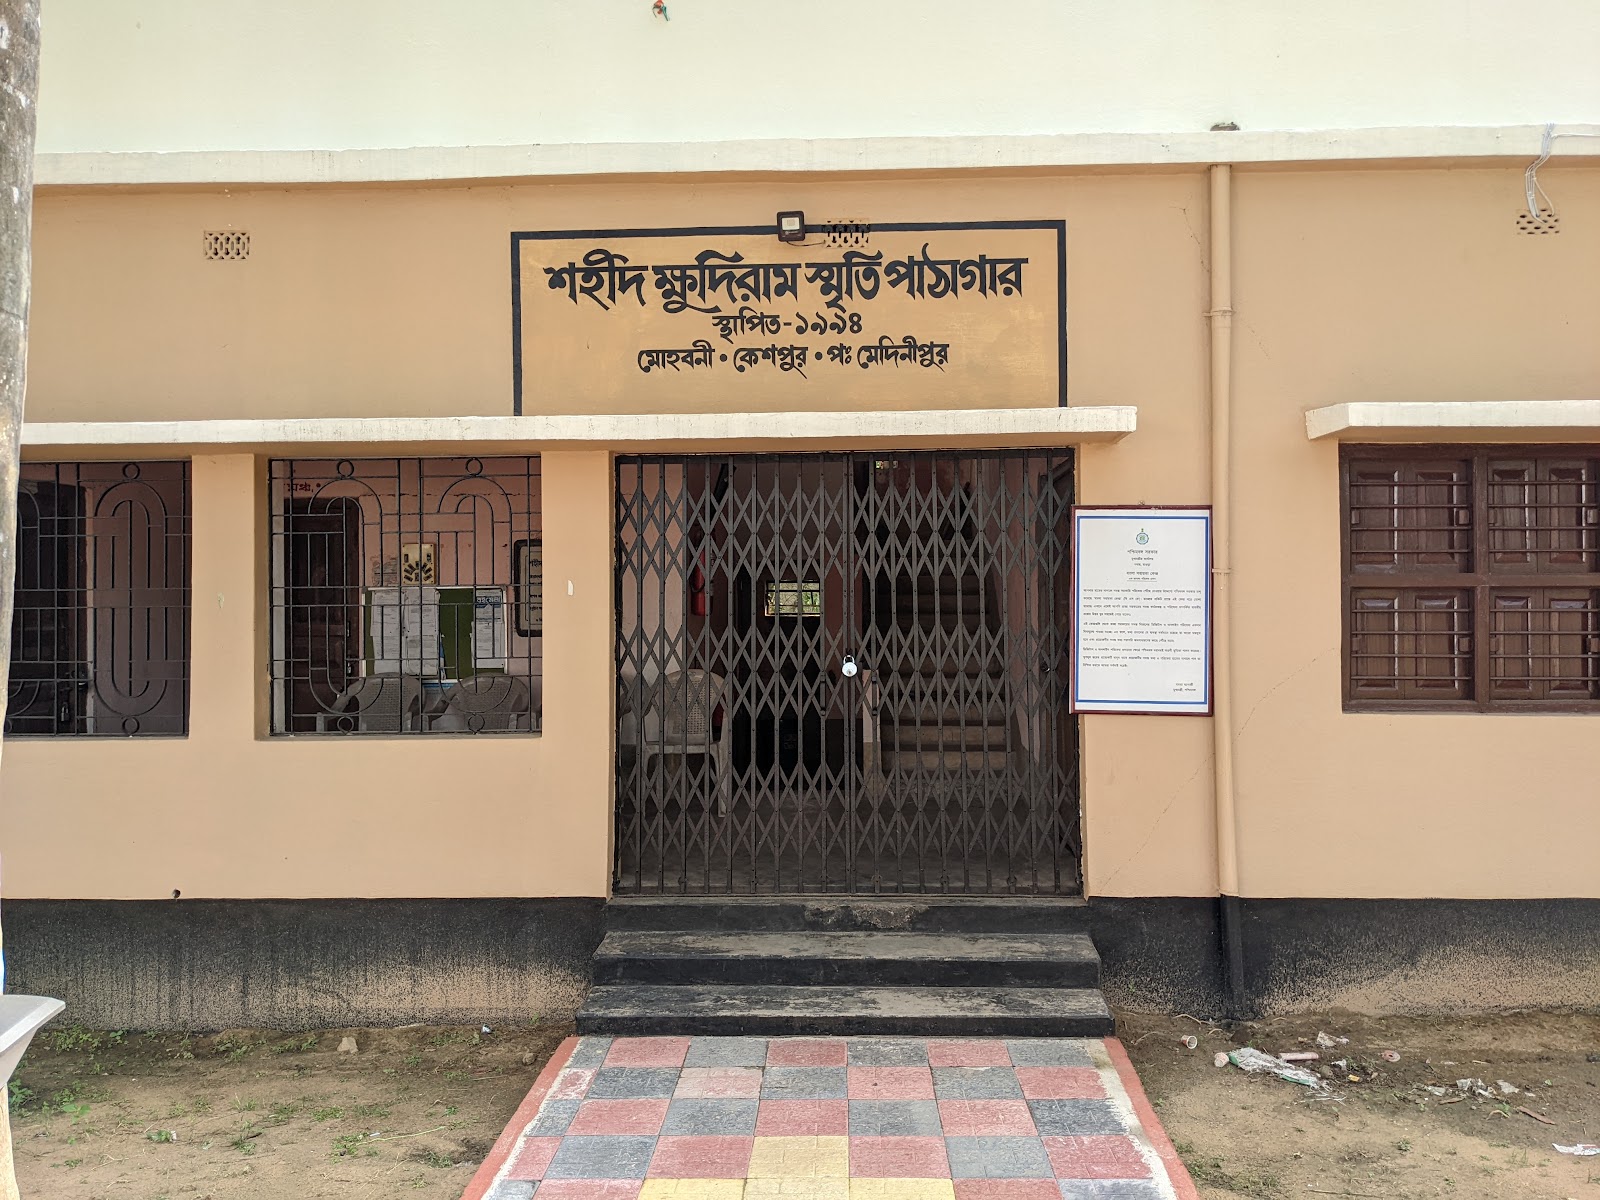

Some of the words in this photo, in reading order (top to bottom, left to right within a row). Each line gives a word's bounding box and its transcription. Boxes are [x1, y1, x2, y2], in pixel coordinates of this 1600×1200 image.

[543, 249, 648, 311] শহীদ
[651, 249, 802, 313] ক্ষুদিরাম
[804, 250, 884, 313] স্মৃতি
[884, 243, 1029, 300] পাঠাগার
[638, 340, 715, 373] মোহবনী
[733, 343, 808, 379] কেশপুর
[857, 335, 950, 371] মেদিনীপুর
